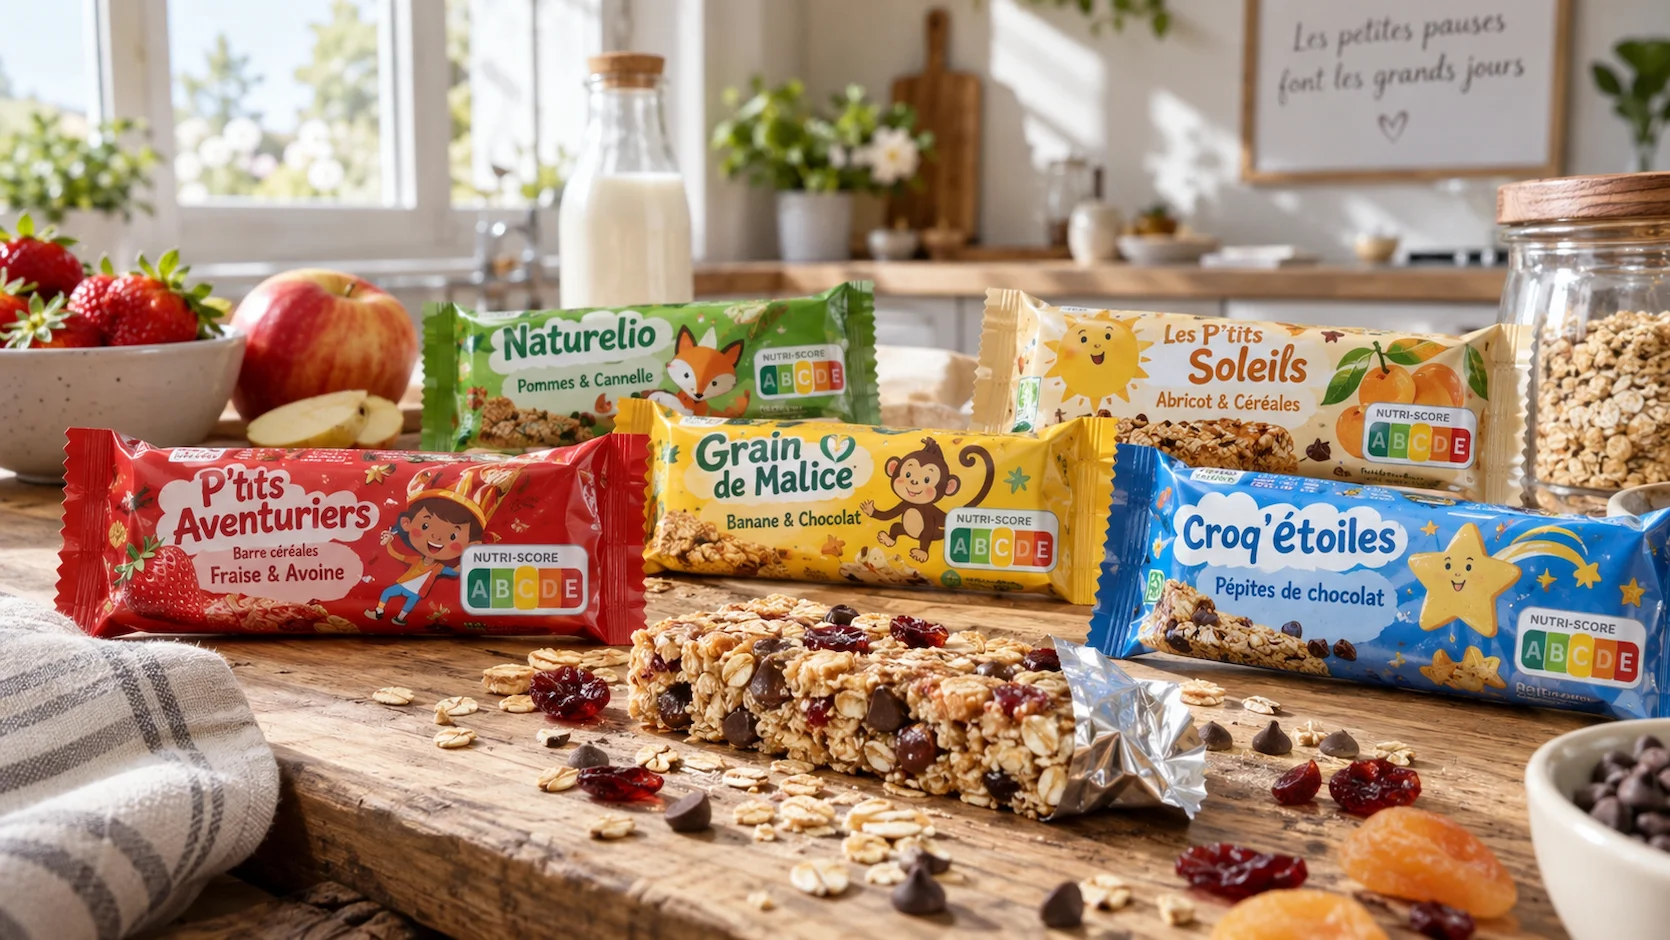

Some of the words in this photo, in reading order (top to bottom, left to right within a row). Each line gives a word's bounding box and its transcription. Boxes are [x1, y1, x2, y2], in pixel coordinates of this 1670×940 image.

[1294, 22, 1328, 52] Les
[1337, 16, 1413, 58] petites
[1422, 13, 1506, 50] pauses
[1278, 67, 1324, 106] font
[1334, 62, 1364, 91] les
[1373, 53, 1455, 101] grands
[1460, 56, 1525, 96] jours
[503, 316, 656, 361] Naturelio
[1163, 324, 1196, 344] Les
[1202, 324, 1263, 345] P'tits
[762, 349, 825, 362] NUTRI-SCORE
[1188, 343, 1308, 385] Soleils
[518, 378, 575, 393] Pommes
[579, 374, 590, 388] &
[594, 368, 653, 387] Cannelle
[1156, 391, 1212, 409] Abricot
[1217, 393, 1228, 409] &
[1234, 393, 1300, 412] Céréales
[1376, 409, 1450, 422] NUTRI-SCORE
[696, 431, 801, 472] Grain
[714, 470, 746, 498] de
[755, 461, 853, 496] Malice
[173, 498, 371, 545] Aventuriers
[727, 514, 779, 530] Banane
[784, 512, 794, 527] &
[799, 509, 861, 526] Chocolat
[957, 514, 1032, 526] NUTRI-SCORE
[233, 546, 267, 560] Barre
[270, 543, 319, 558] céréales
[473, 552, 558, 563] NUTRI-SCORE
[211, 566, 262, 584] Fraise
[267, 565, 280, 582] &
[285, 563, 345, 582] Avoine
[1215, 576, 1275, 601] Pépites
[1281, 580, 1301, 600] de
[1307, 582, 1385, 607] chocolat
[1530, 614, 1616, 634] NUTRI-SCORE
